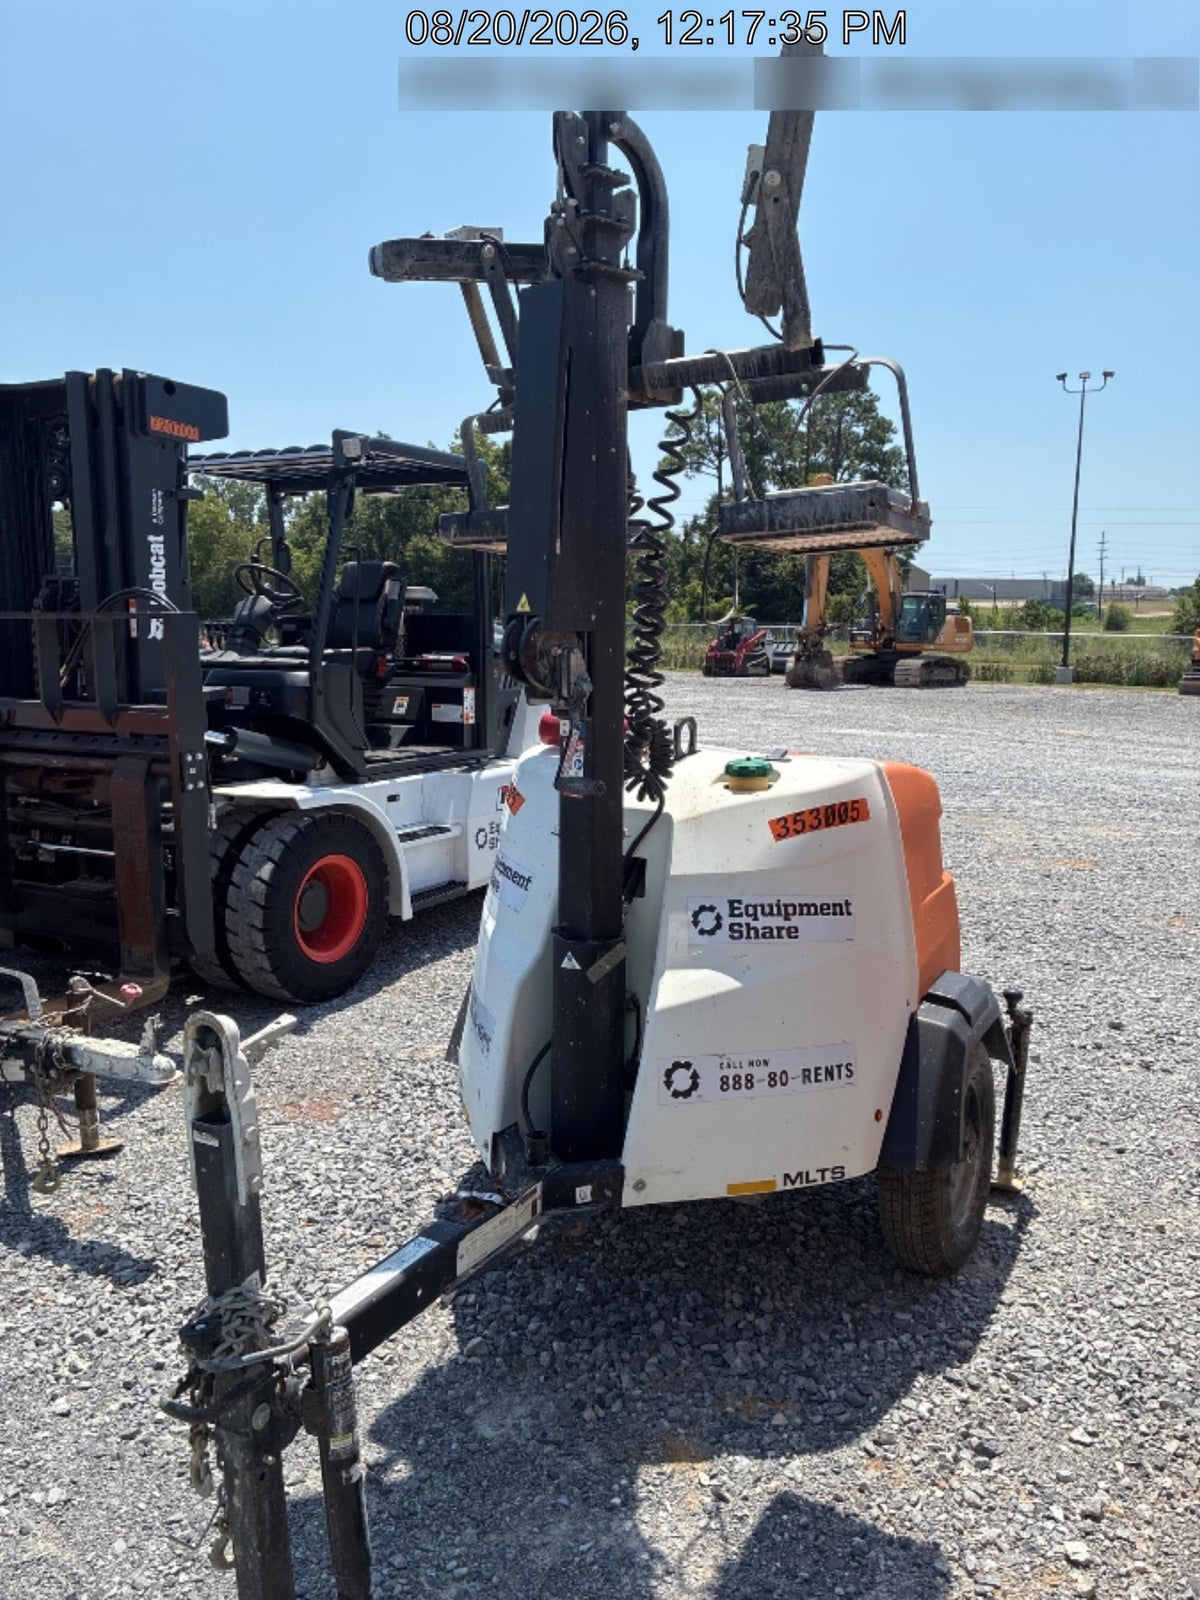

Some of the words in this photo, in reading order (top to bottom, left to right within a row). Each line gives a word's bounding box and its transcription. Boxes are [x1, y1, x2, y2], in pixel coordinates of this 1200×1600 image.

[147, 535, 167, 606] obcat
[775, 799, 860, 839] 353005
[727, 899, 853, 922] Equipment
[728, 922, 800, 941] Share
[719, 1061, 744, 1071] CALL
[748, 1059, 770, 1068] NOW
[719, 1062, 854, 1093] 888-80-RENTS
[782, 1165, 846, 1187] MLTS
